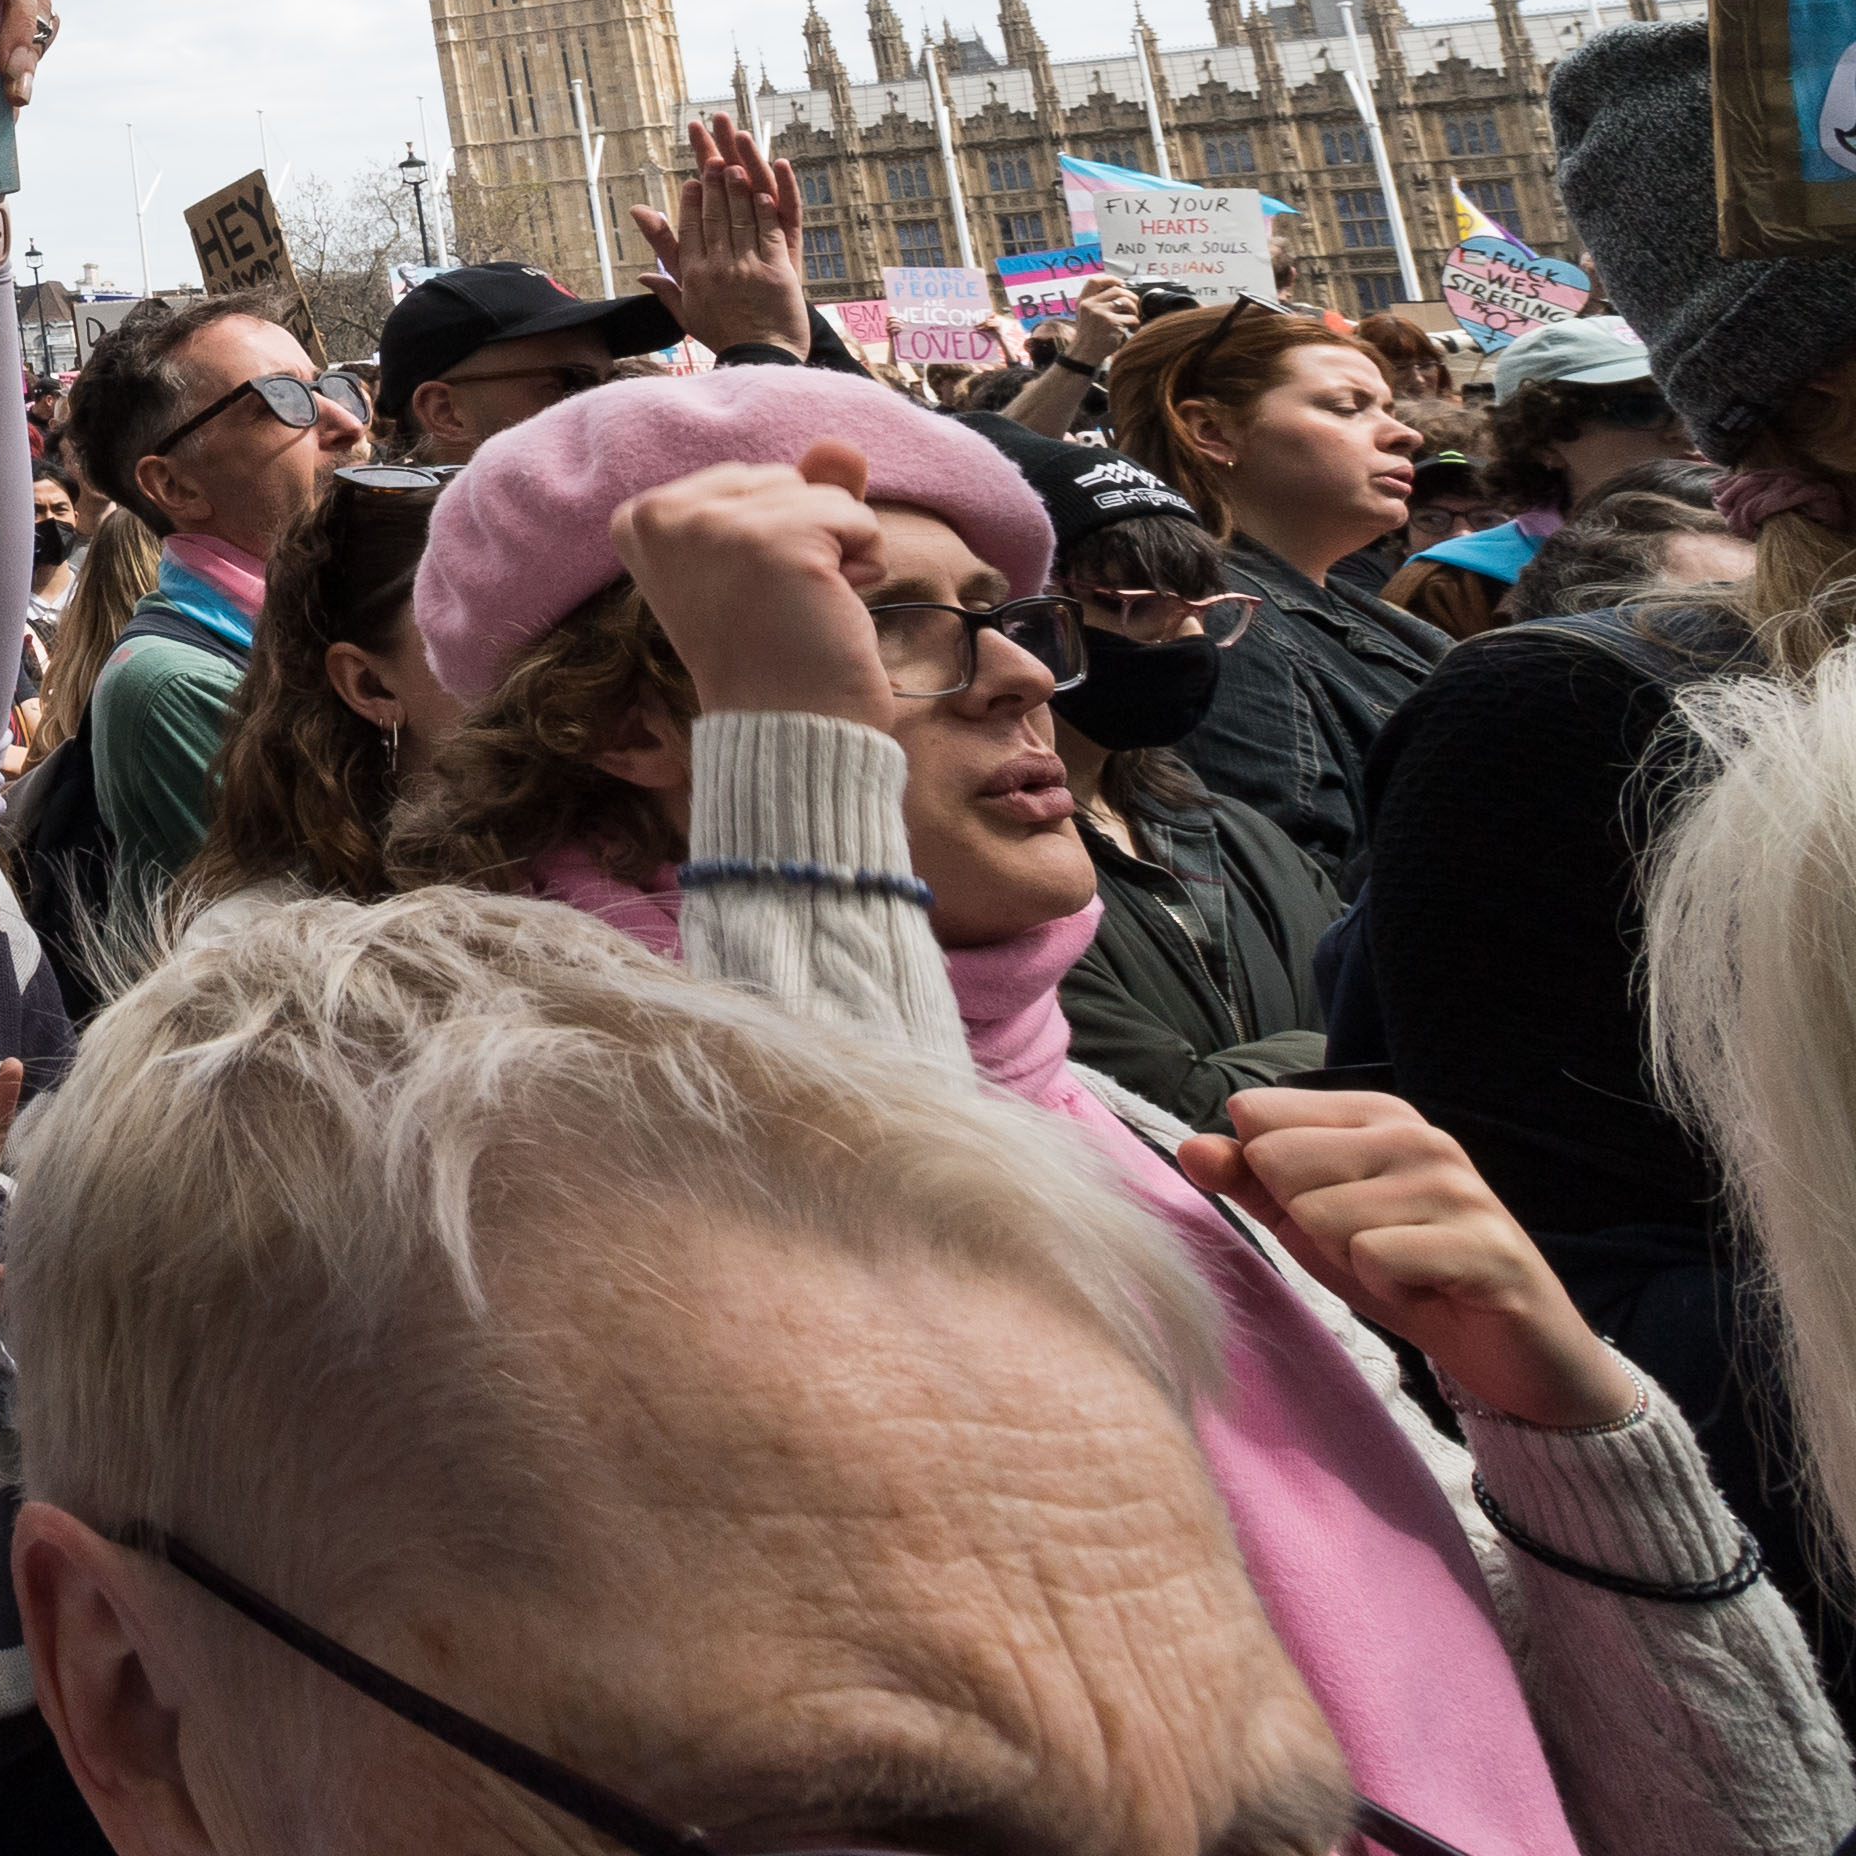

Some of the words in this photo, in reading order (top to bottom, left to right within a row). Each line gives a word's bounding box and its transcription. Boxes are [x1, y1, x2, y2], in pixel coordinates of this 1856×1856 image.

[1104, 197, 1152, 215] FIX
[1169, 196, 1231, 214] YOUR
[1115, 243, 1146, 255] AND
[1156, 243, 1191, 255] YOUR
[1202, 242, 1253, 255] SOULS.
[899, 269, 966, 281] TRANS
[1491, 251, 1559, 286] FUCK
[893, 281, 979, 298] PEOPLE
[1489, 271, 1544, 298] WES
[1017, 290, 1076, 319] BEL
[1448, 273, 1568, 323] STREETING
[890, 306, 992, 327] WELCOME
[893, 330, 992, 361] LOVED
